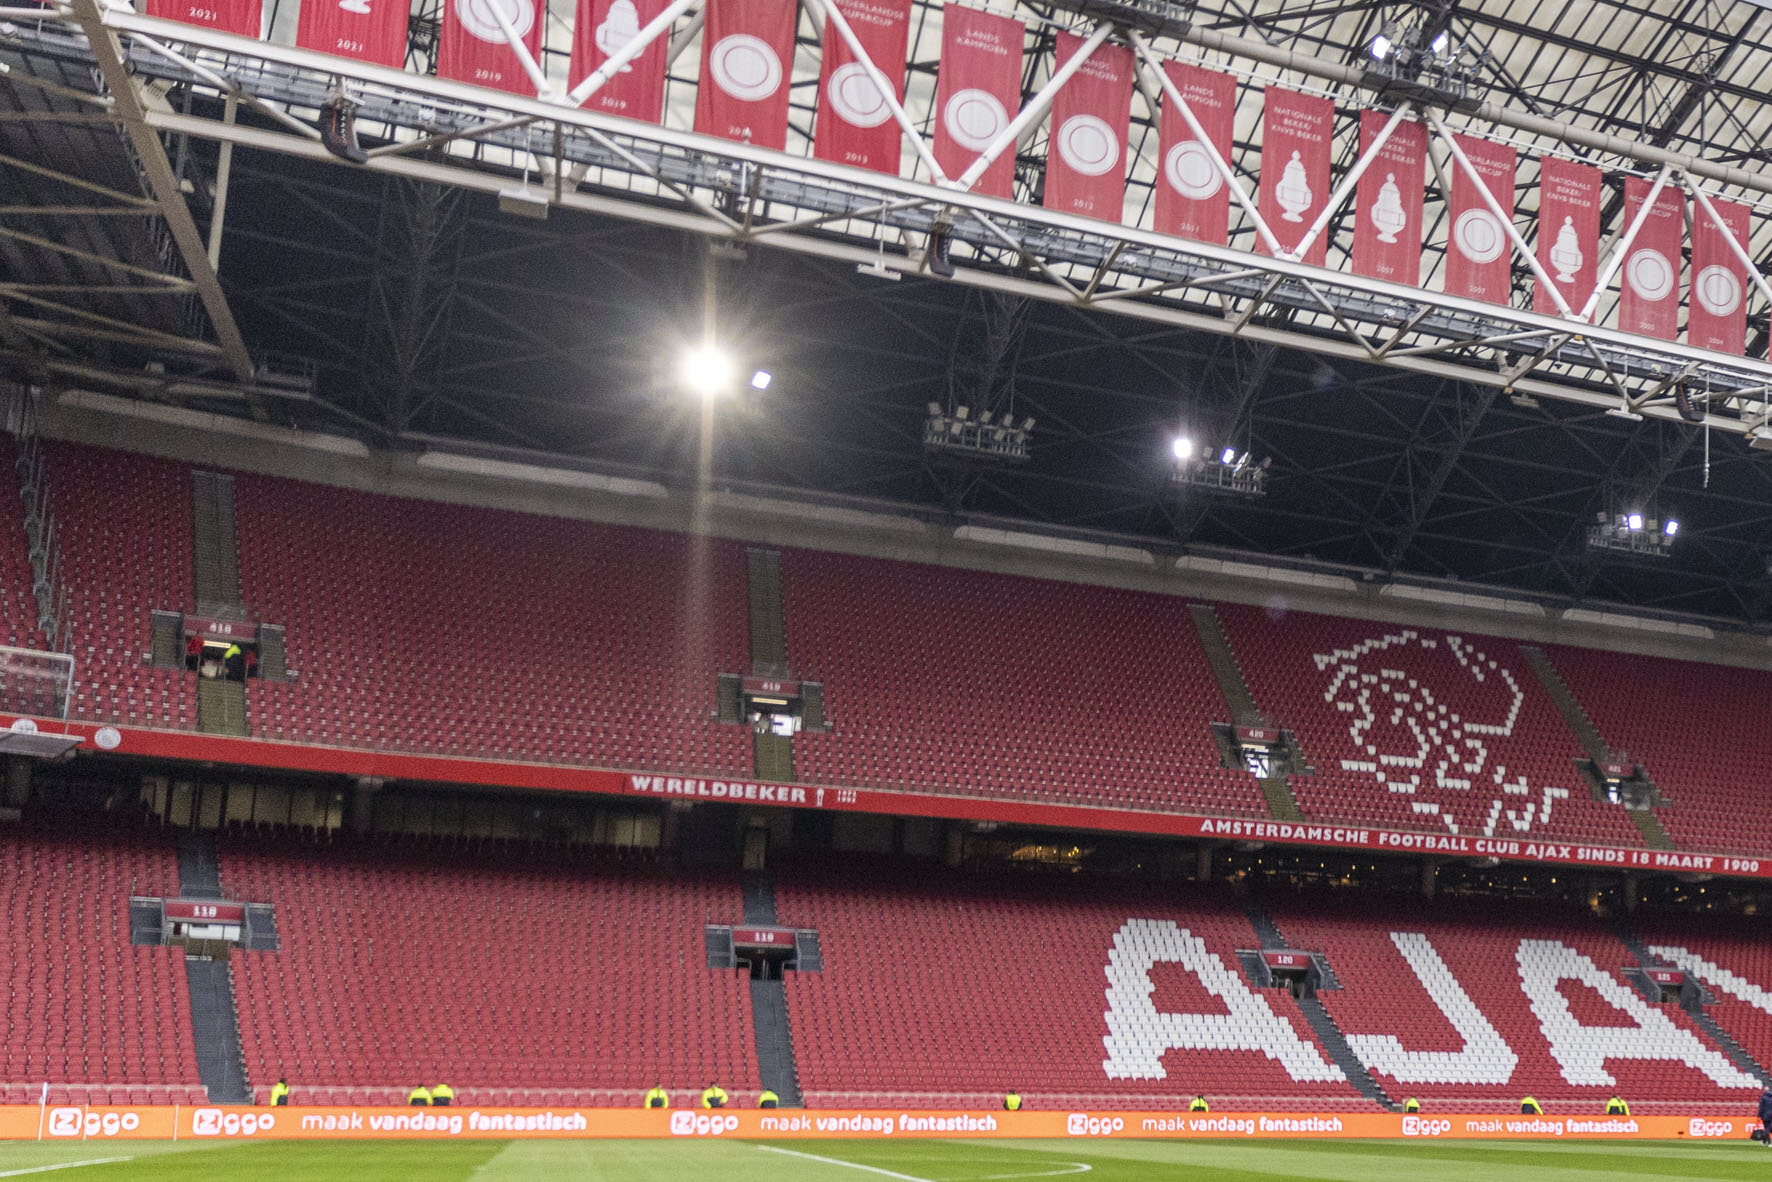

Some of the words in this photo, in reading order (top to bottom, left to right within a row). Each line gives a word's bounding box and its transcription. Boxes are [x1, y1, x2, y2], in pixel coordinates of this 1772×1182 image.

[189, 7, 217, 22] 2021
[336, 38, 363, 53] 2021
[1179, 92, 1222, 109] AMPIOEN
[631, 774, 807, 804] WERELDBEKER
[1200, 819, 1370, 845] AMSTERDAMSCHE
[1378, 832, 1468, 852] FOOTBALL
[1475, 839, 1519, 855] CLUB
[1525, 843, 1571, 860] AJAX
[1577, 848, 1625, 863] SINDS
[1632, 852, 1650, 866] 18
[1655, 854, 1714, 870] MAART
[1723, 859, 1760, 873] 1900
[49, 1107, 140, 1136] Ziggo
[192, 1107, 275, 1136] Ziggo
[302, 1112, 363, 1131] maak
[369, 1112, 463, 1135] vandaag
[468, 1111, 587, 1131] fantastisch
[670, 1110, 739, 1136] Ziggo
[760, 1114, 811, 1132] maak
[816, 1114, 894, 1135] vandaag
[899, 1113, 997, 1132] fantastisch
[1067, 1112, 1124, 1136] Ziggo
[1142, 1116, 1185, 1132] maak
[1189, 1116, 1255, 1135] vandaag
[1259, 1115, 1343, 1133] fantastisch
[1402, 1115, 1451, 1136] Ziggo
[1466, 1118, 1503, 1132] maak
[1506, 1118, 1563, 1136] vandaag
[1566, 1118, 1640, 1134] fantastisch
